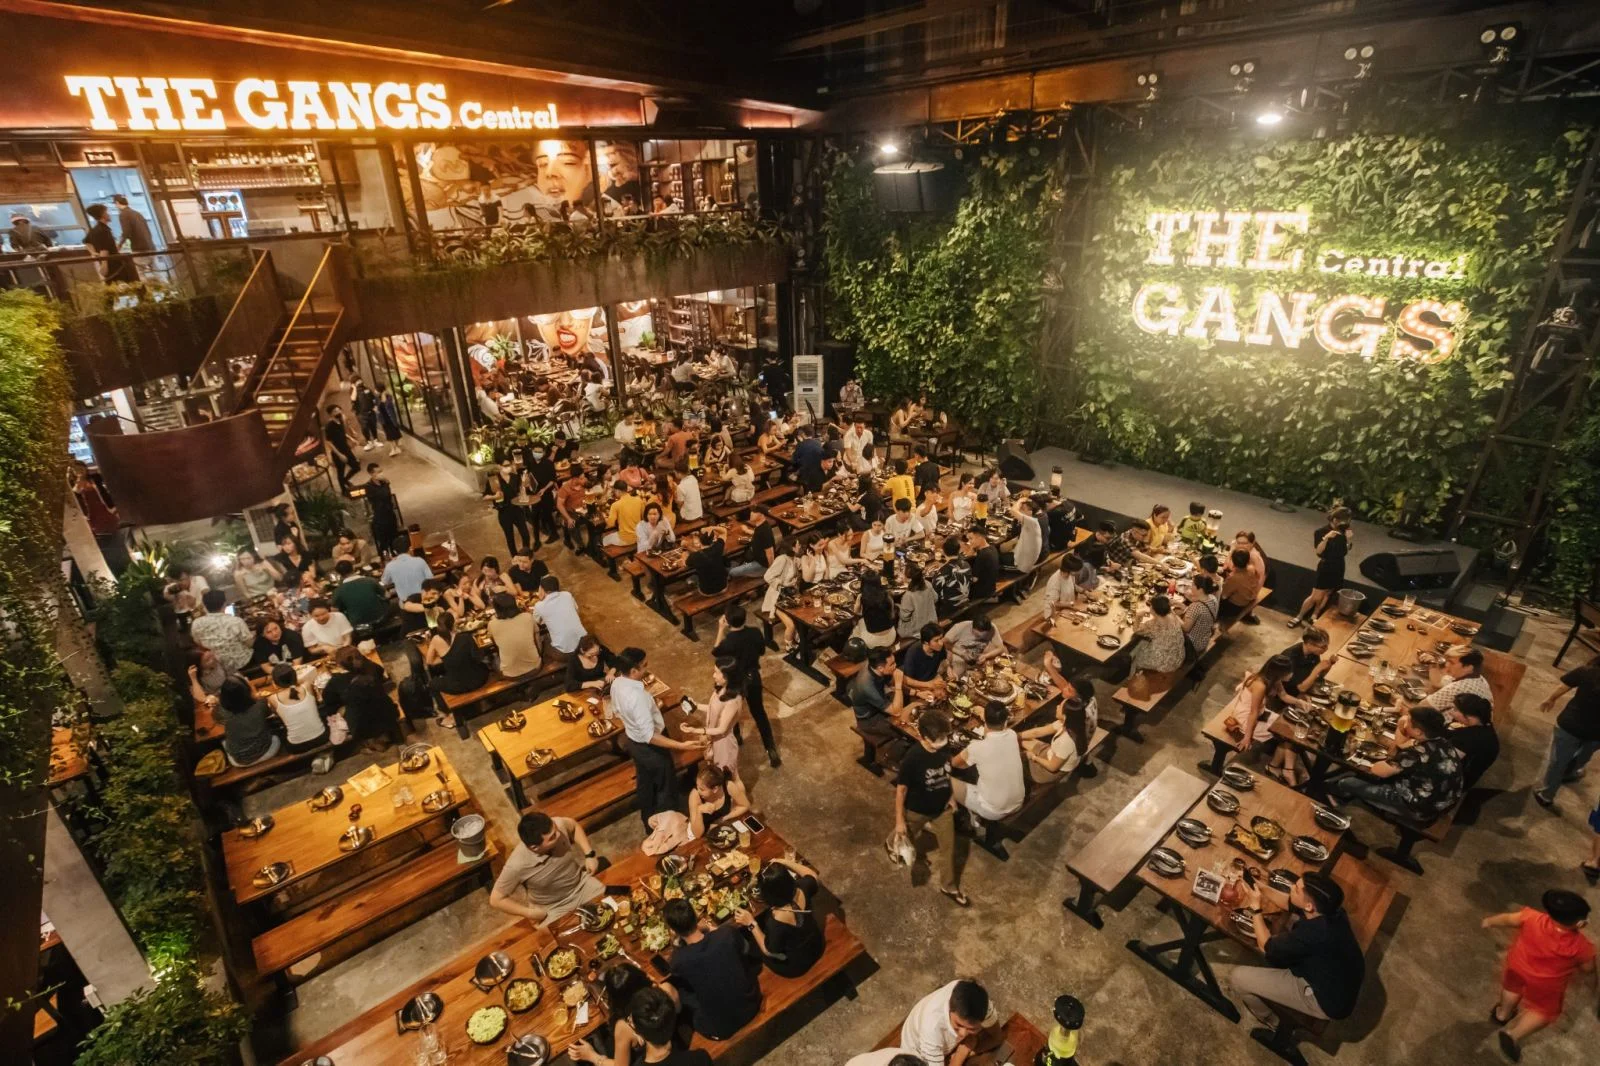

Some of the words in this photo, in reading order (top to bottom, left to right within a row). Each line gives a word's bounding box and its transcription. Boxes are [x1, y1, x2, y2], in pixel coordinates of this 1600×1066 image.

[65, 76, 226, 131] THE
[233, 78, 453, 131] GANGS
[459, 102, 560, 130] Central
[1145, 209, 1309, 270] THE
[1317, 249, 1467, 279] Central
[1132, 283, 1466, 364] GANGS
